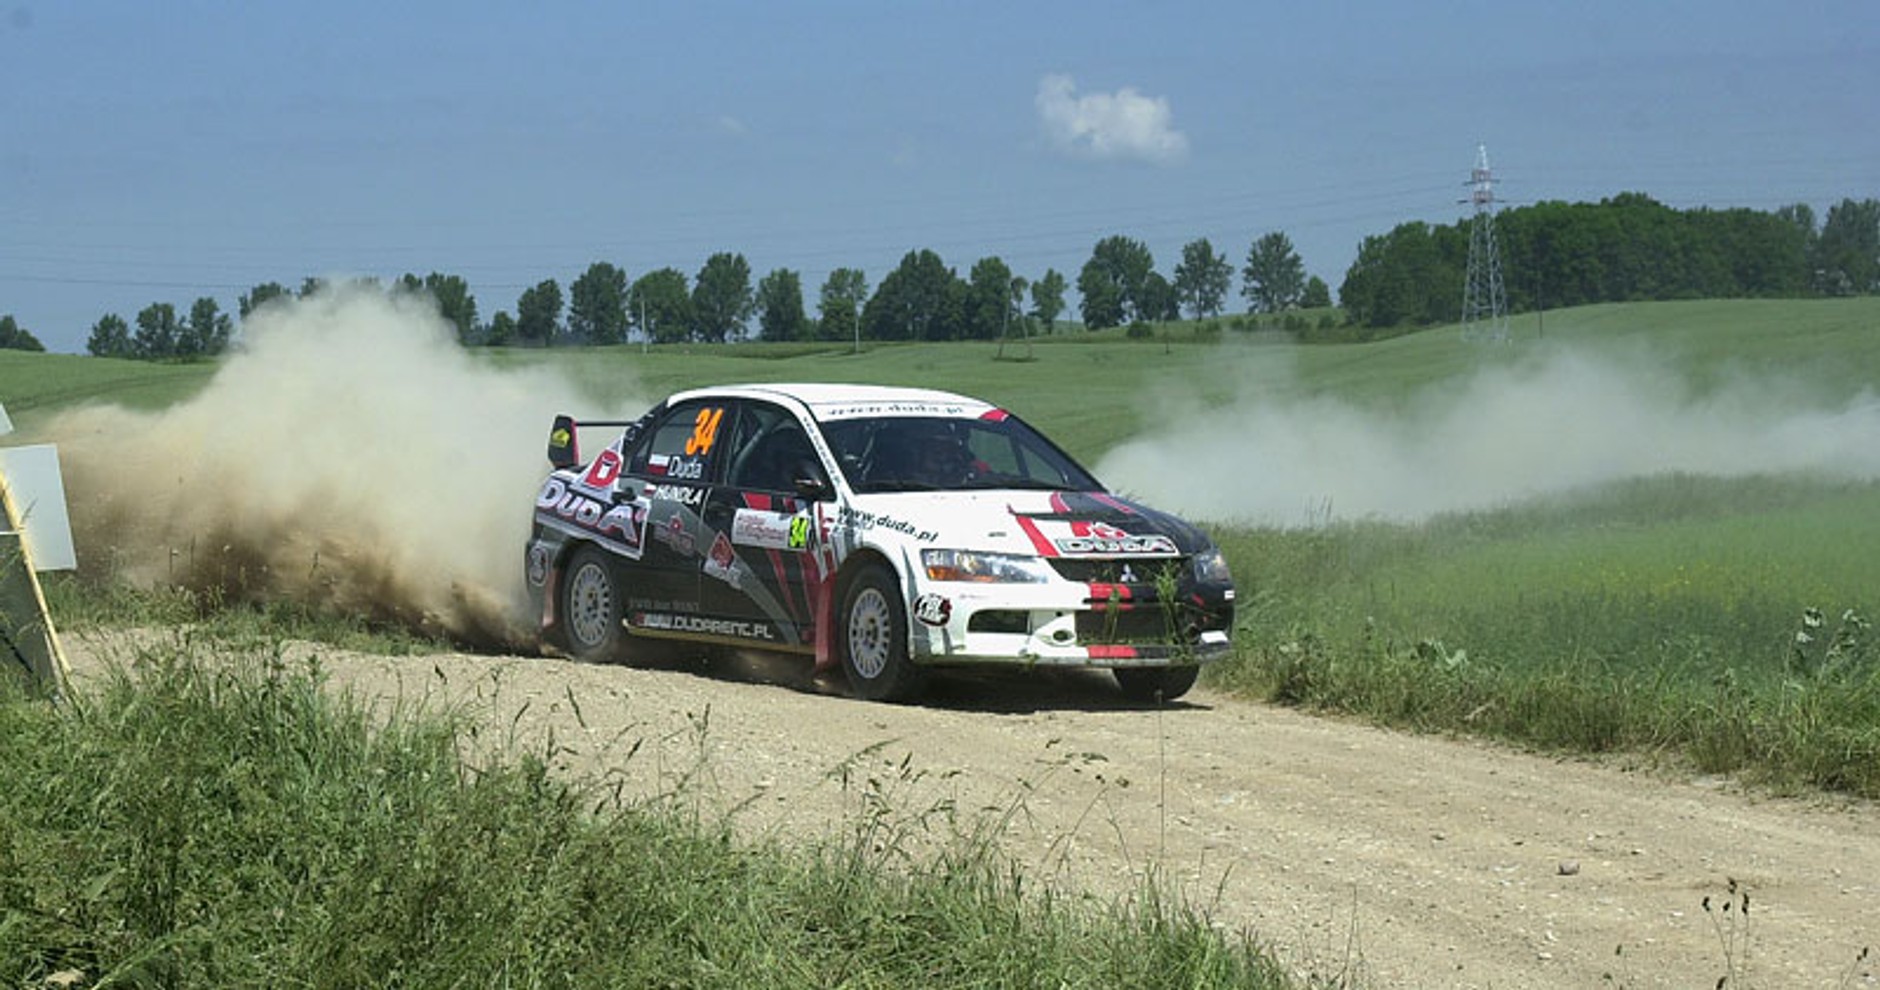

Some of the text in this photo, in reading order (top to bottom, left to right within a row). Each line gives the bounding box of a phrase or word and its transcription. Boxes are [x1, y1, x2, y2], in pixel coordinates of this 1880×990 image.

[685, 408, 723, 455] 34
[668, 456, 703, 478] Duda
[789, 518, 808, 548] 34
[839, 506, 939, 542] www.duda.pl
[1057, 538, 1177, 553] DUDA
